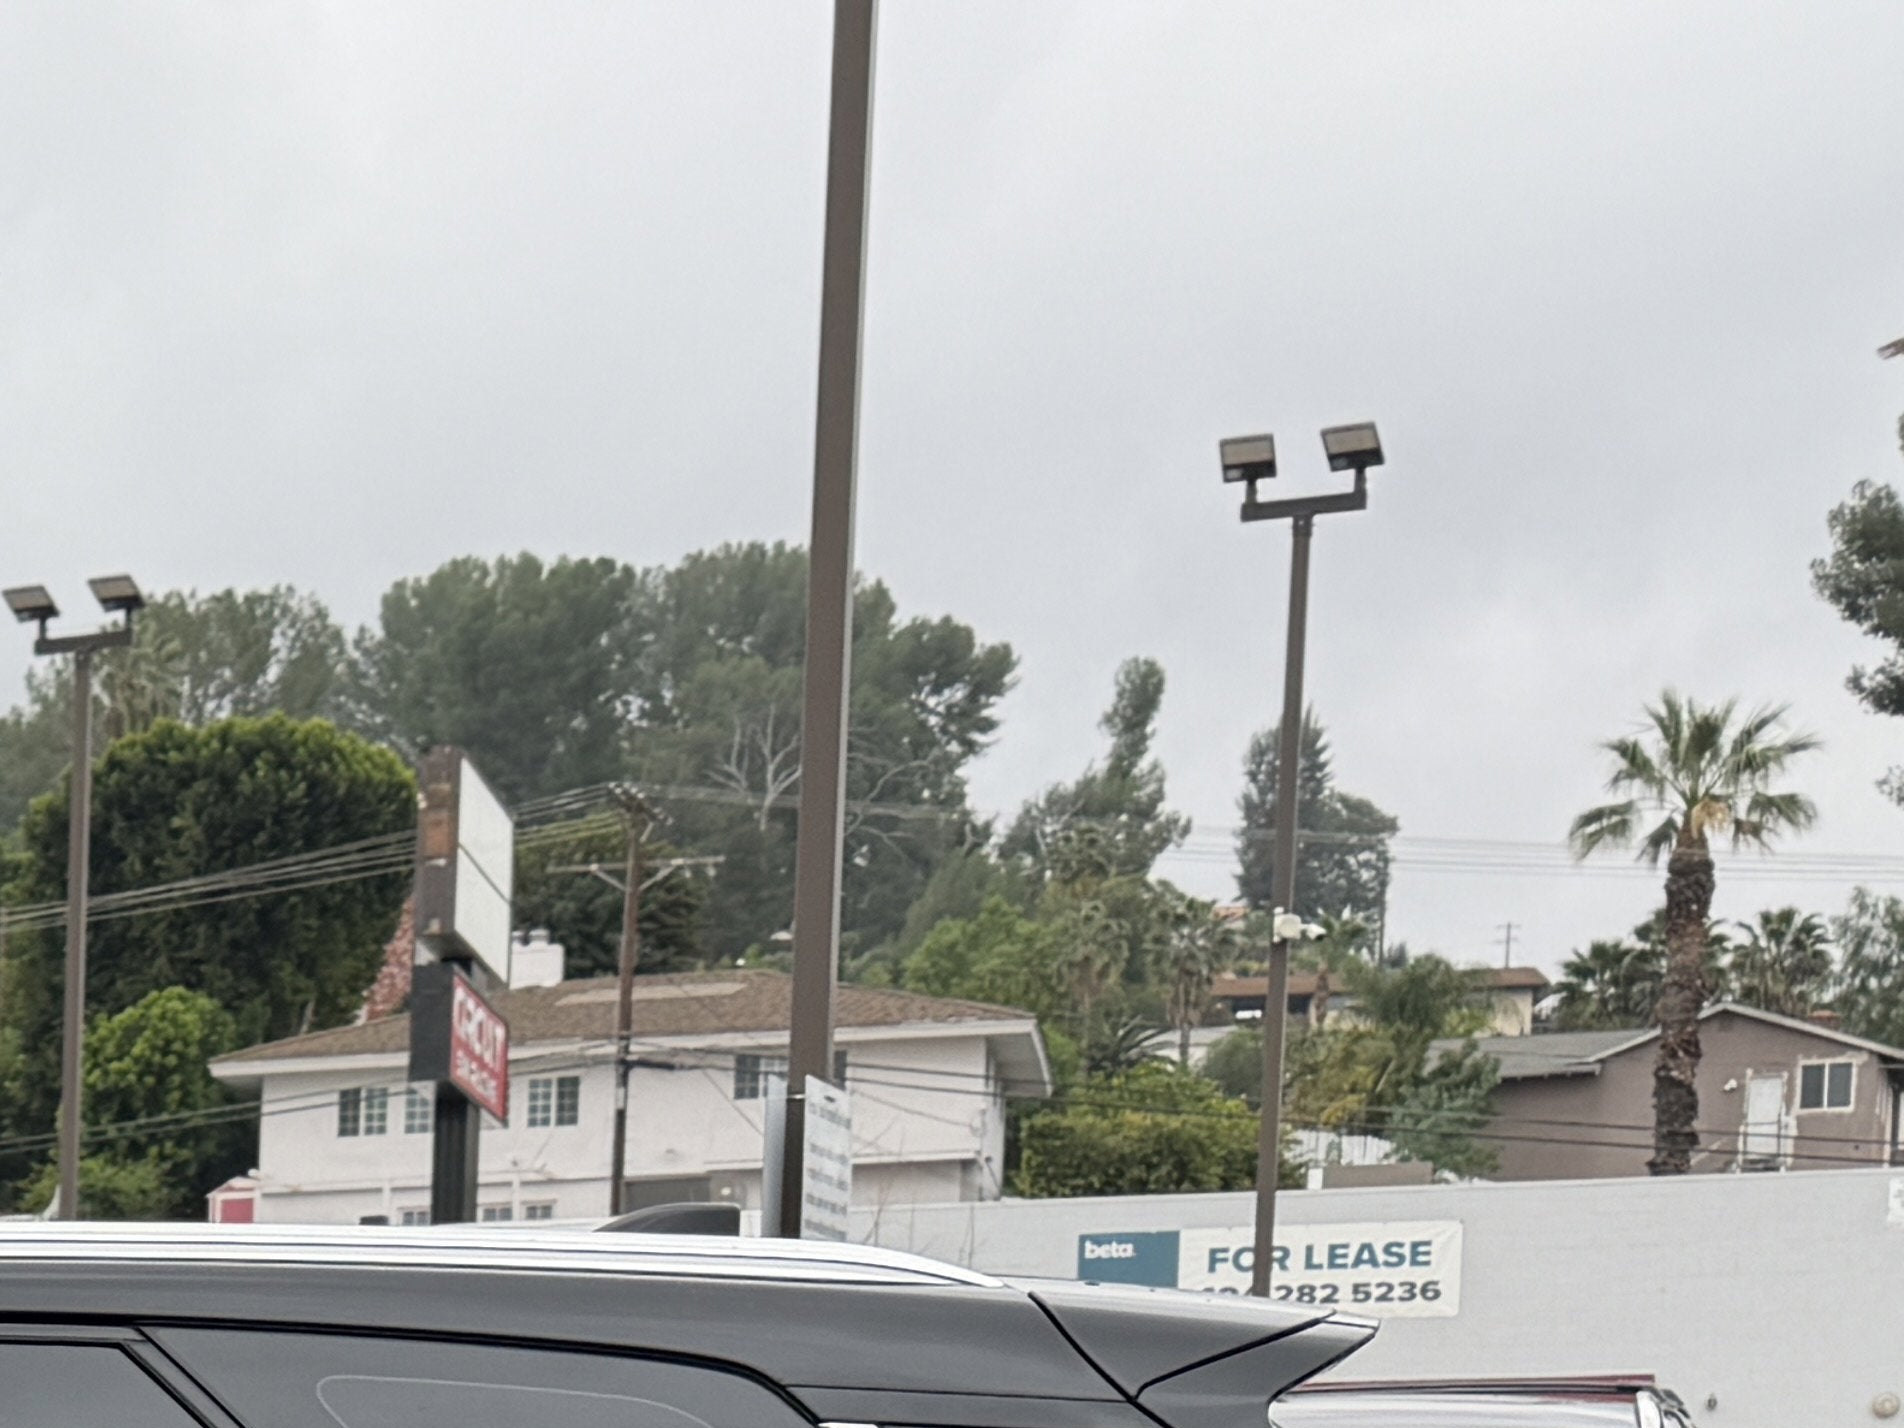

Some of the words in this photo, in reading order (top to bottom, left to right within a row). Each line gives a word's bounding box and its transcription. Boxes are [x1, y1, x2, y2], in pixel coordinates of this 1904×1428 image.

[1084, 1241, 1133, 1258] beta
[1207, 1243, 1291, 1274] FOR
[1303, 1240, 1434, 1271] LEASE
[1274, 1283, 1340, 1305] 282
[1350, 1280, 1442, 1303] 5236
